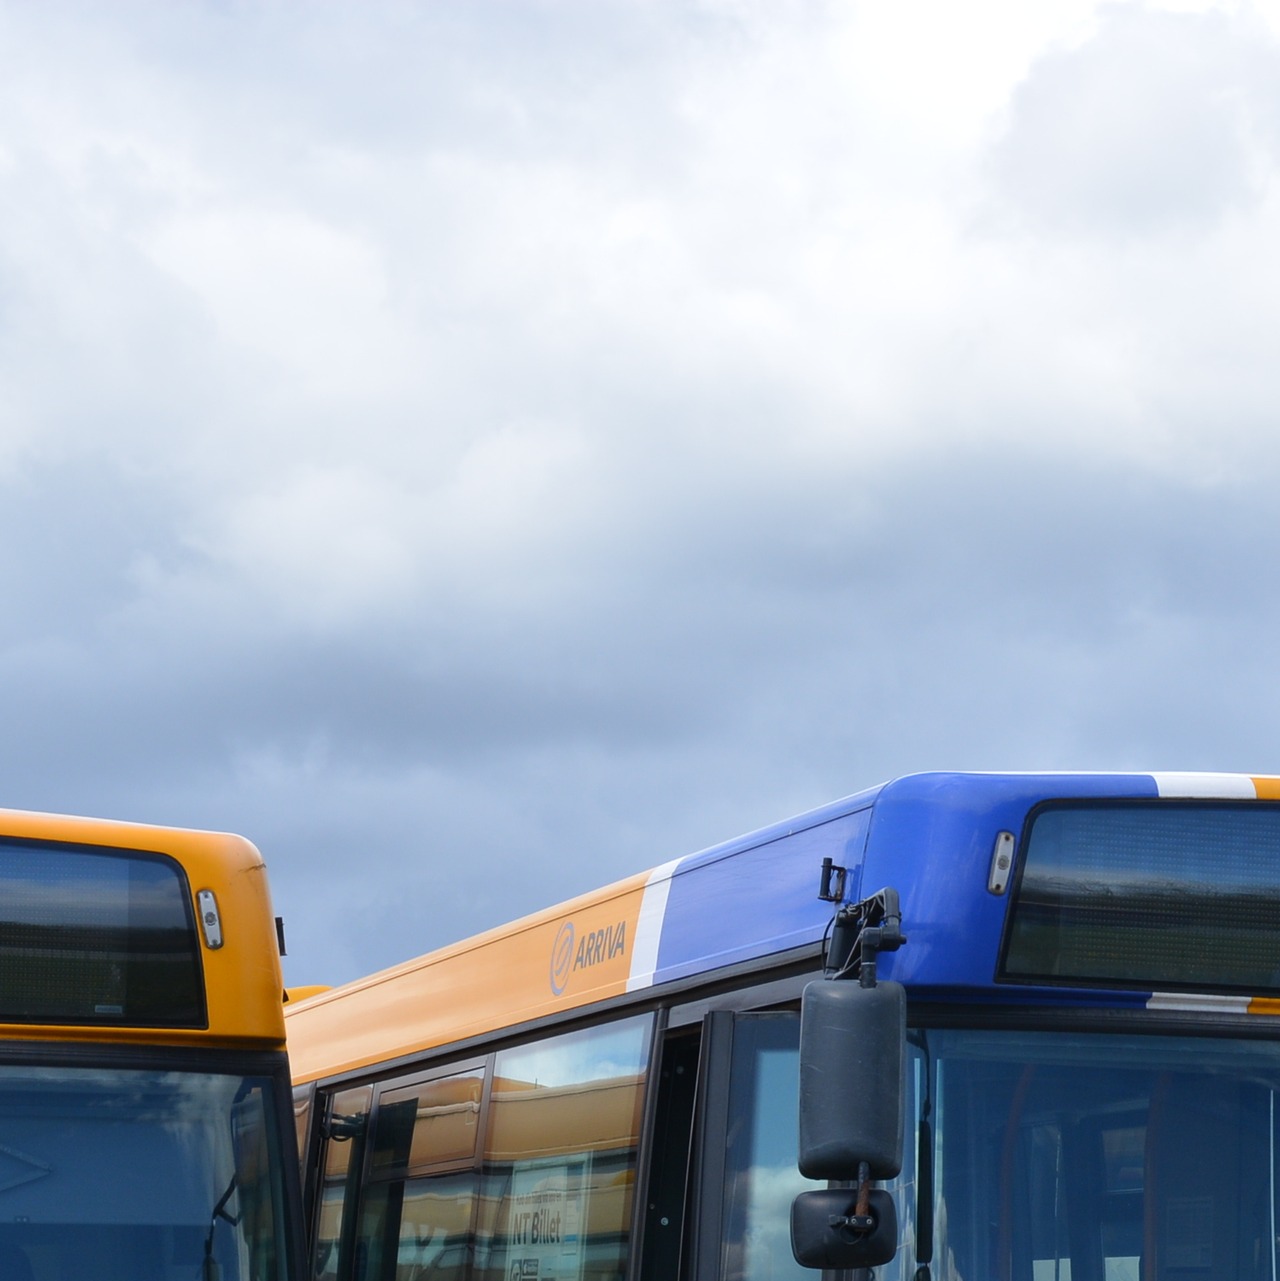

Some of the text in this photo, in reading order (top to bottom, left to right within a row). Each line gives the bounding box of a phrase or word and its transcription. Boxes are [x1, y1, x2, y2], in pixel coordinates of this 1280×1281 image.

[572, 920, 626, 972] ARRIVA
[513, 1209, 561, 1245] NT Billet
